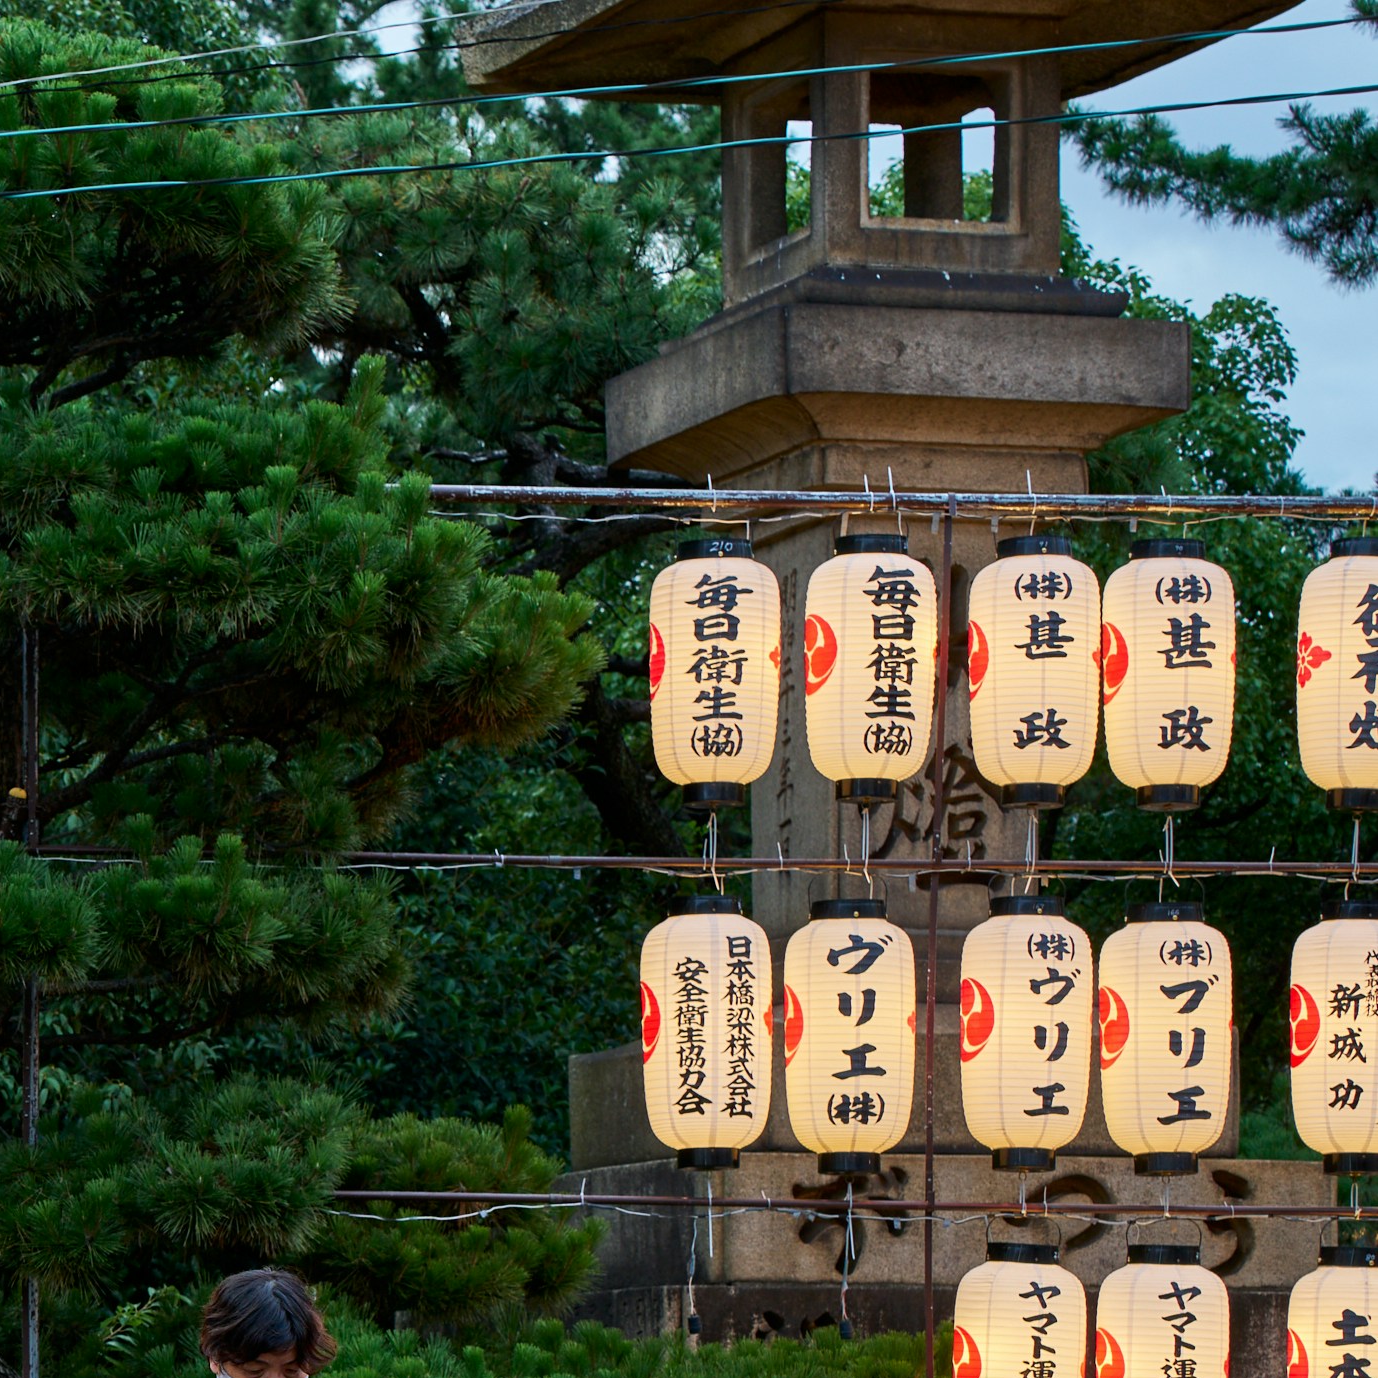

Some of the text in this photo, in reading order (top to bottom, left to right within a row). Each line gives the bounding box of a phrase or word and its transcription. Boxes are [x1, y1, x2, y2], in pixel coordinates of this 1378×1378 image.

[709, 541, 733, 553] 210
[686, 574, 753, 756] 毎日衛生(協)
[862, 565, 922, 756] 毎日衛生(協)
[674, 958, 712, 1114] 安全衛生協力会
[722, 936, 755, 1118] 日本橋梁株式会社
[1328, 983, 1366, 1112] 新城功
